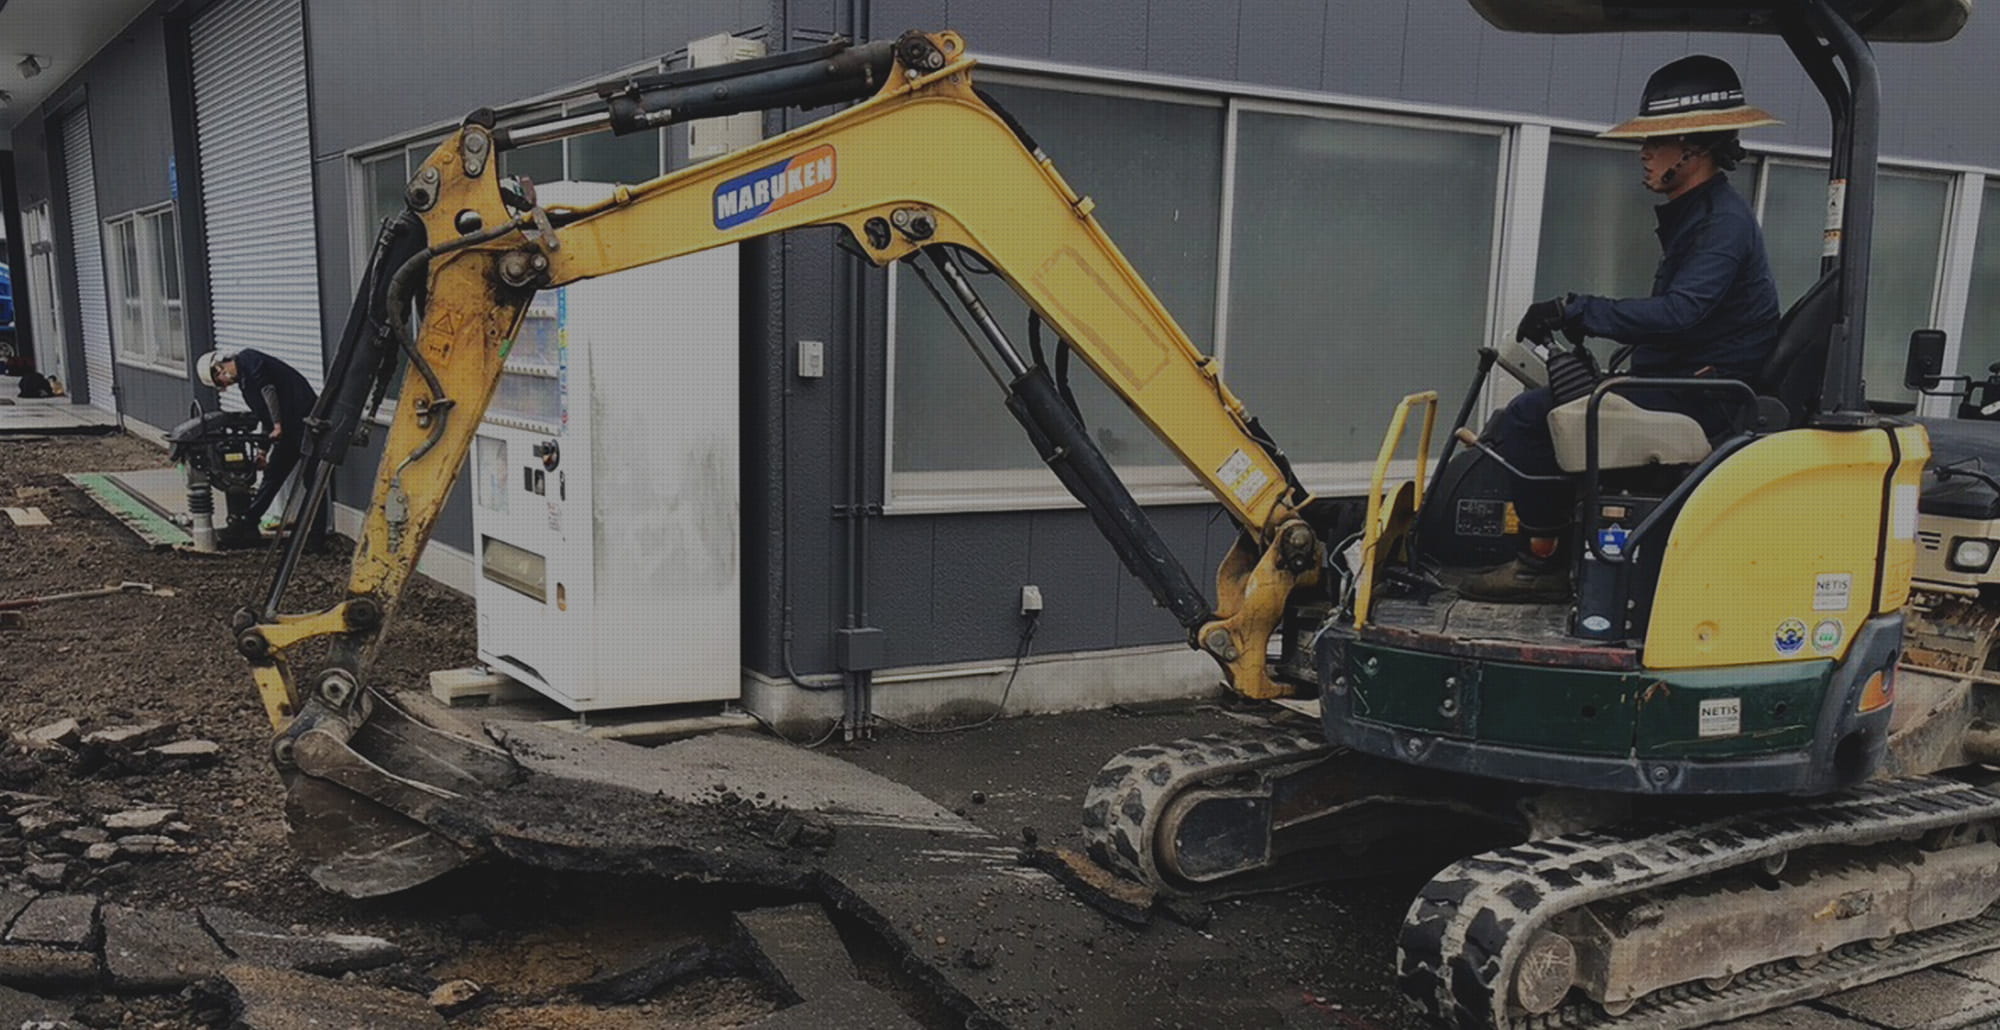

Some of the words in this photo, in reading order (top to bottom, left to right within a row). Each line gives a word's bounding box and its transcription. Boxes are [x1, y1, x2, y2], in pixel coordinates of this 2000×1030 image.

[717, 155, 833, 220] MARUKEN
[1816, 580, 1848, 590] NETIS
[1702, 704, 1738, 716] NETIS
